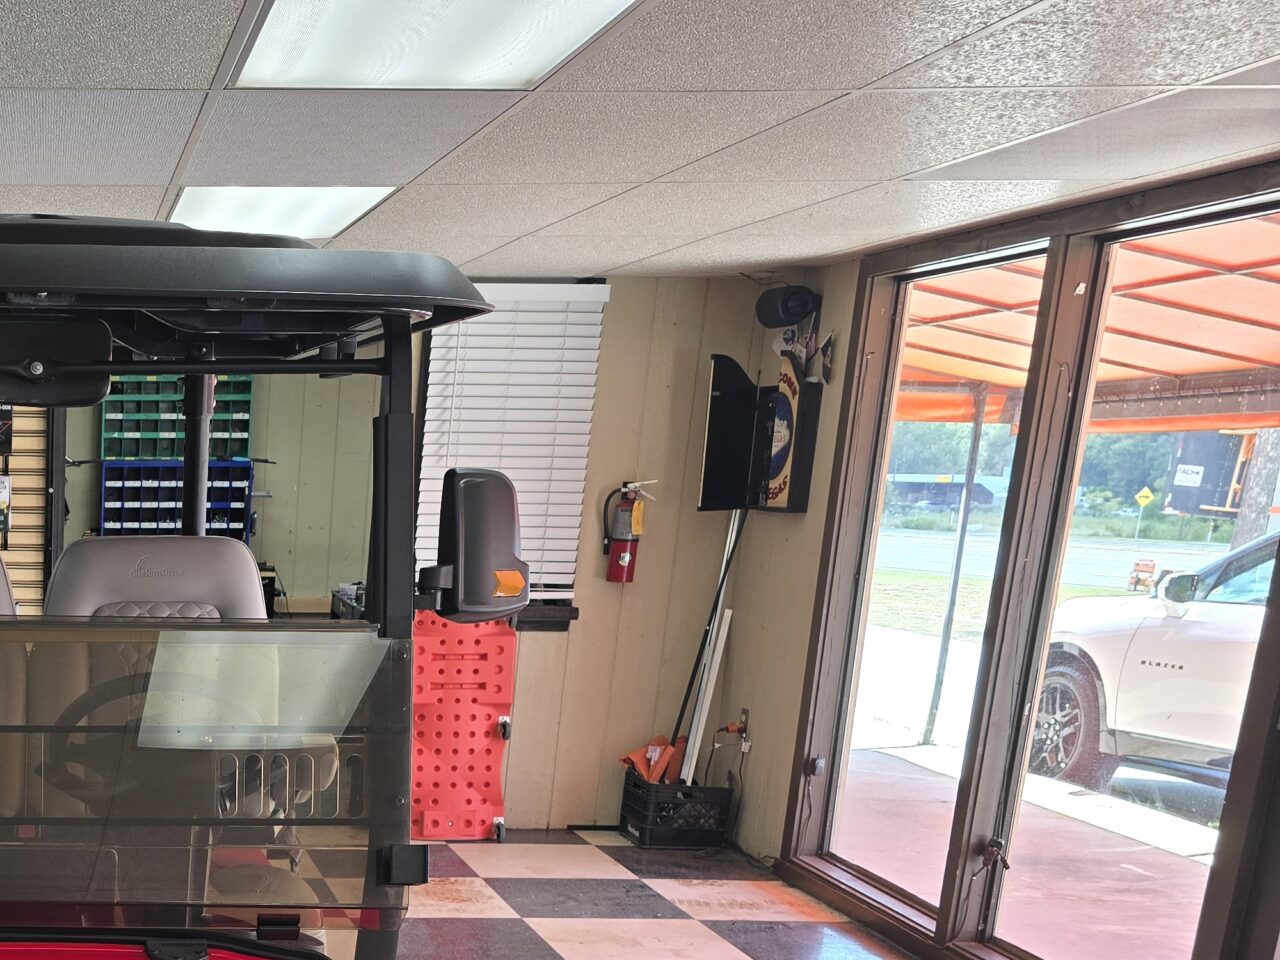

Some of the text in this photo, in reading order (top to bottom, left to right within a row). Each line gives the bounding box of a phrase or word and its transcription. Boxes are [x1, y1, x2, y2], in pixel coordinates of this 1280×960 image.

[773, 435, 786, 443] EGAS
[767, 475, 789, 501] EGAS
[1140, 660, 1184, 670] BLAZER
